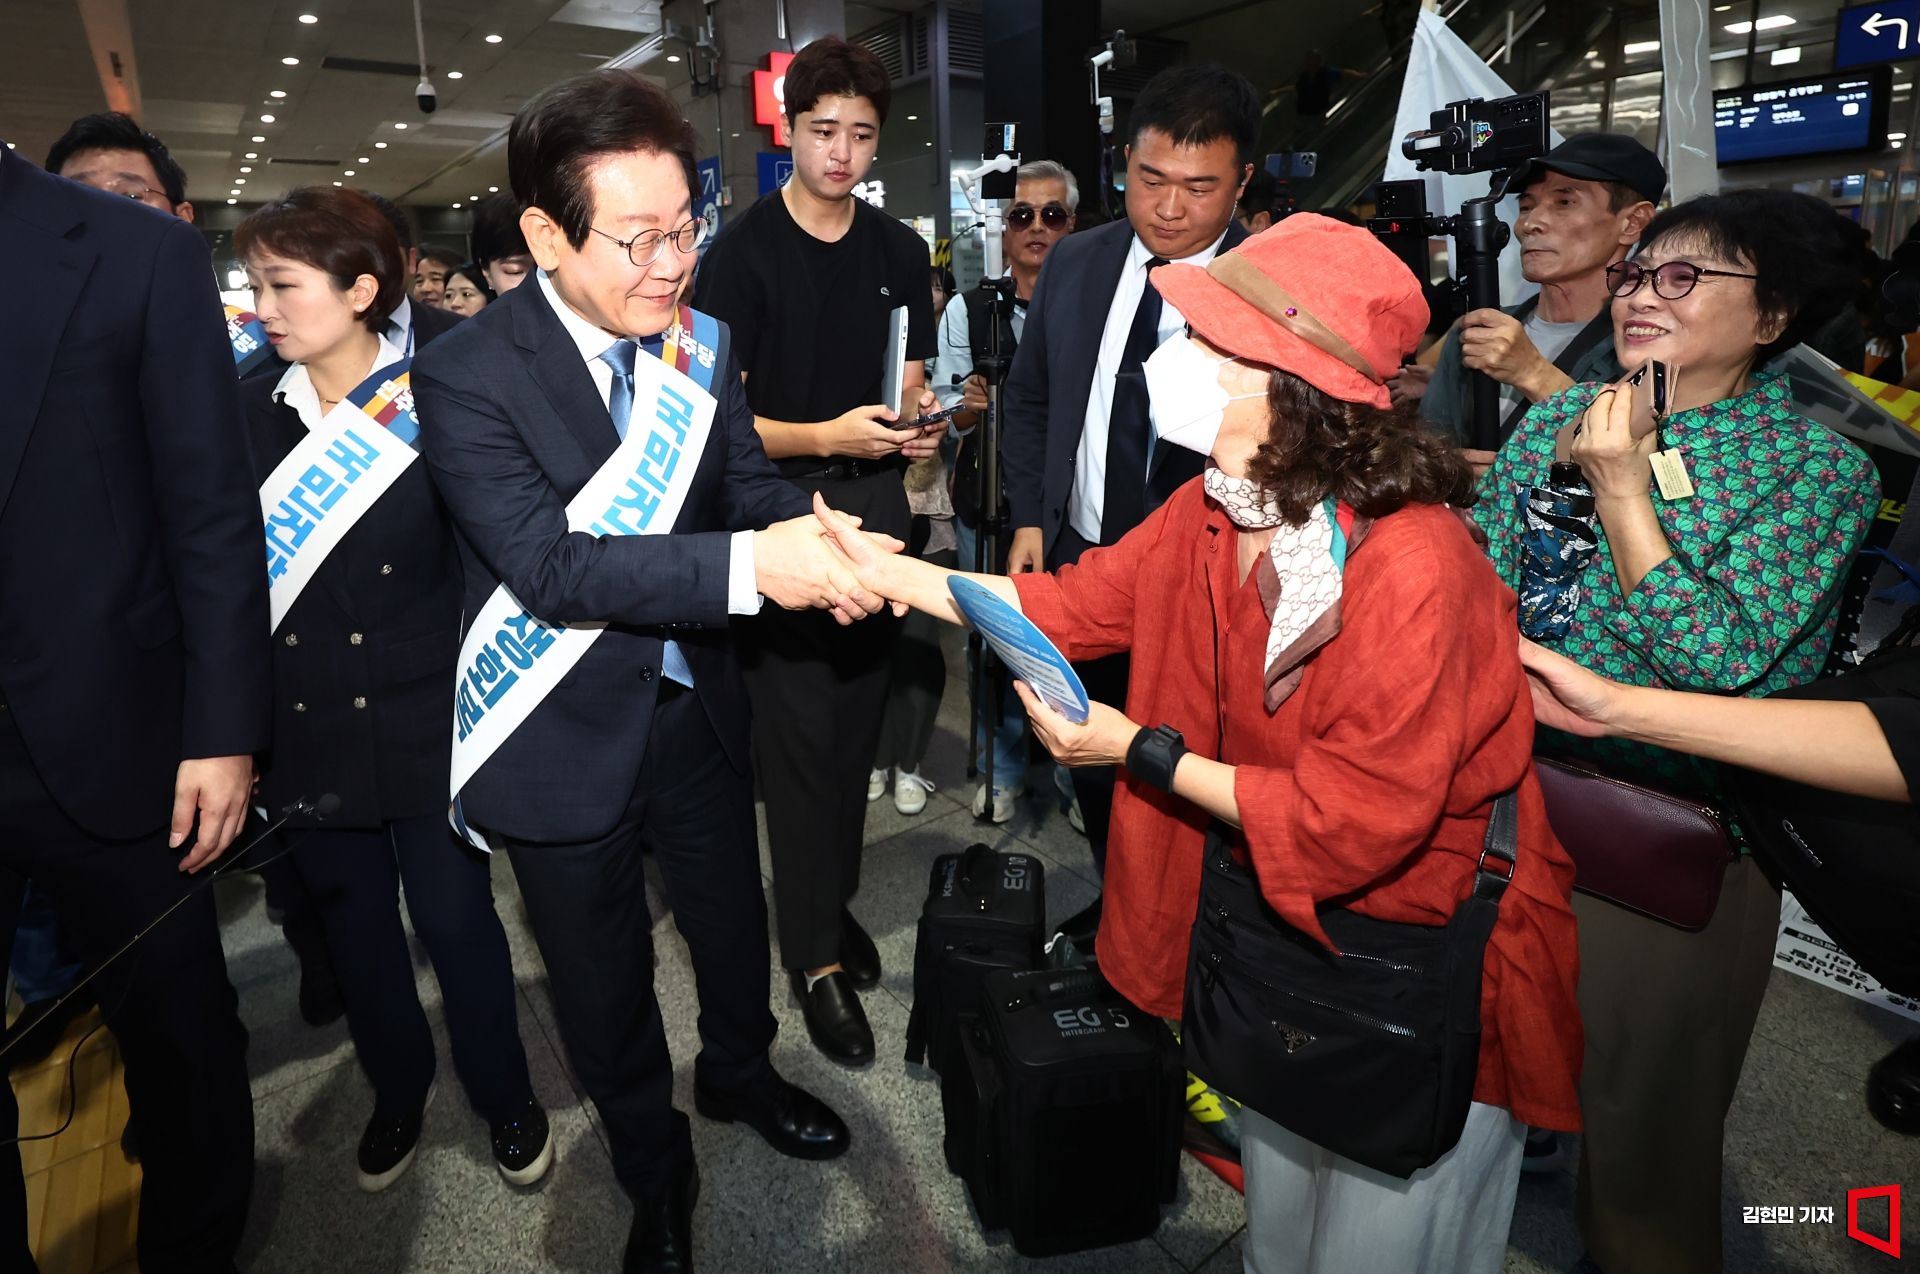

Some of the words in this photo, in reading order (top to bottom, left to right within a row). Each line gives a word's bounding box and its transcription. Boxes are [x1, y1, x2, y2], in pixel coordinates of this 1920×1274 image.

[456, 610, 566, 744] 생회복
[1053, 1006, 1101, 1030] EG
[1108, 1008, 1131, 1029] 5
